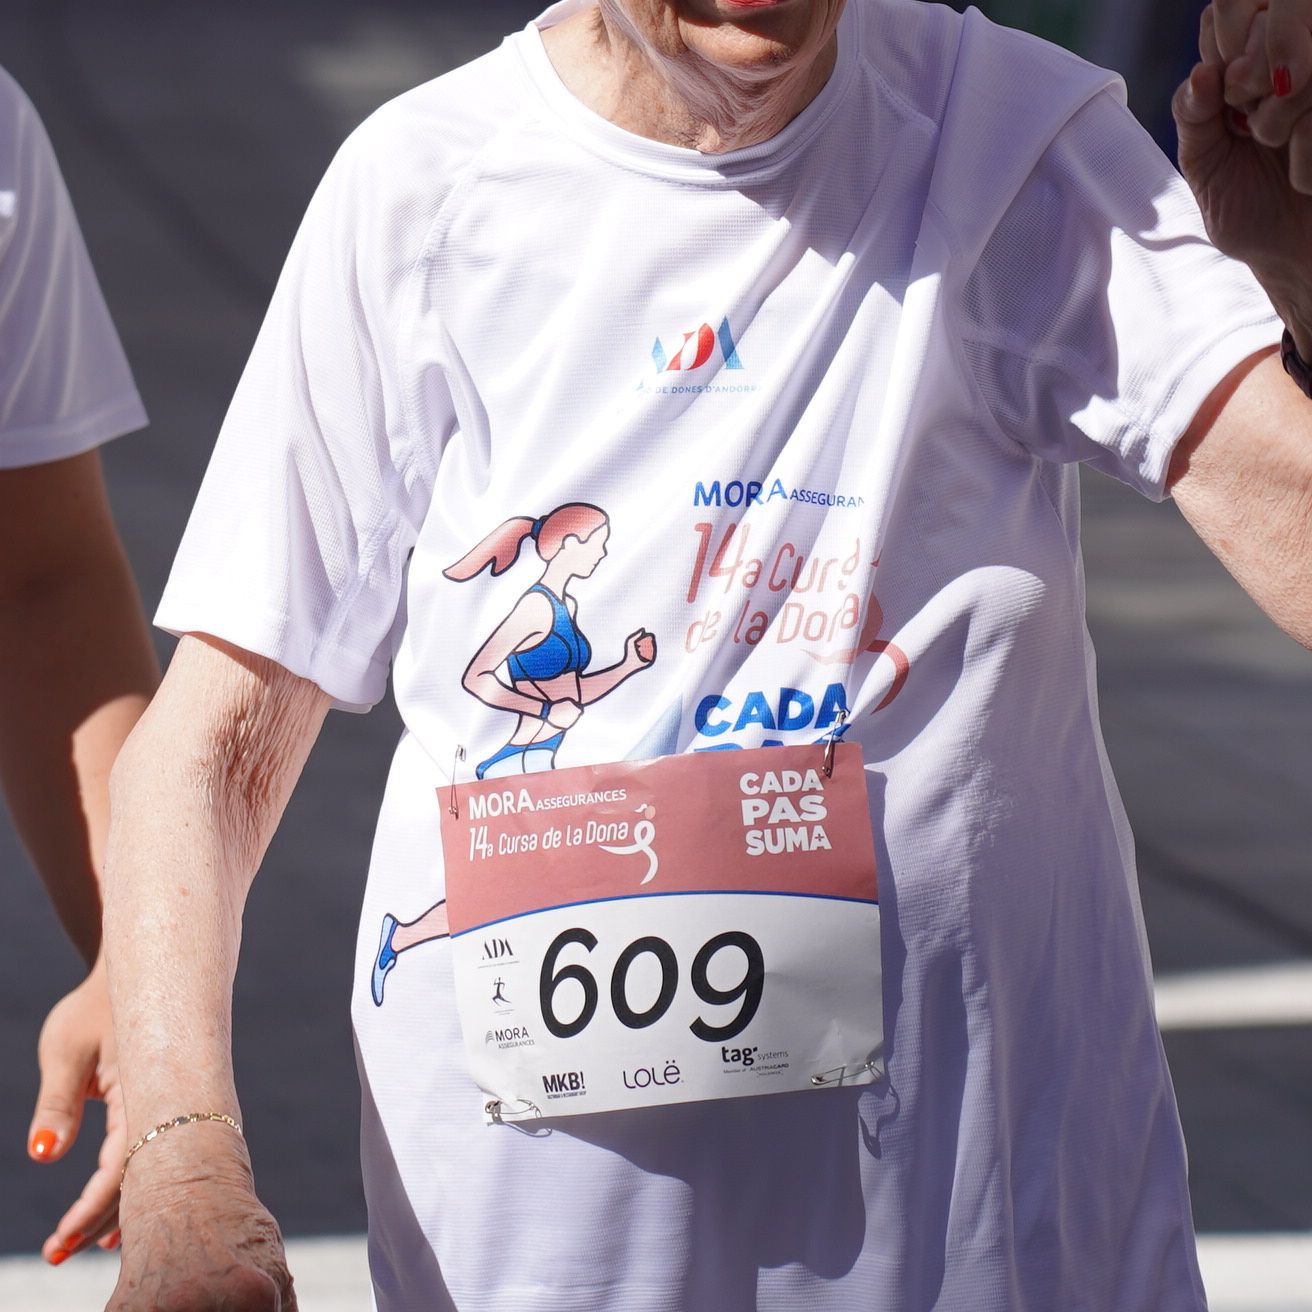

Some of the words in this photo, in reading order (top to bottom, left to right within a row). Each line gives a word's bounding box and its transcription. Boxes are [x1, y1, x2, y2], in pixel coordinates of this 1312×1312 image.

[671, 385, 705, 394] DONES
[693, 478, 788, 508] MORA
[734, 600, 769, 645] la
[694, 682, 851, 736] CADA
[739, 769, 825, 795] CADA
[468, 788, 535, 821] MORA
[535, 789, 627, 811] ASSEGURANCES
[741, 795, 828, 826] PAS
[499, 832, 539, 855] Cursa
[542, 826, 562, 850] de
[566, 825, 583, 846] la
[586, 820, 630, 844] Dona
[745, 825, 833, 856] SUMA
[539, 927, 765, 1042] 609
[495, 1027, 529, 1042] MORA
[757, 1051, 789, 1061] systems
[542, 1071, 585, 1093] MKB!
